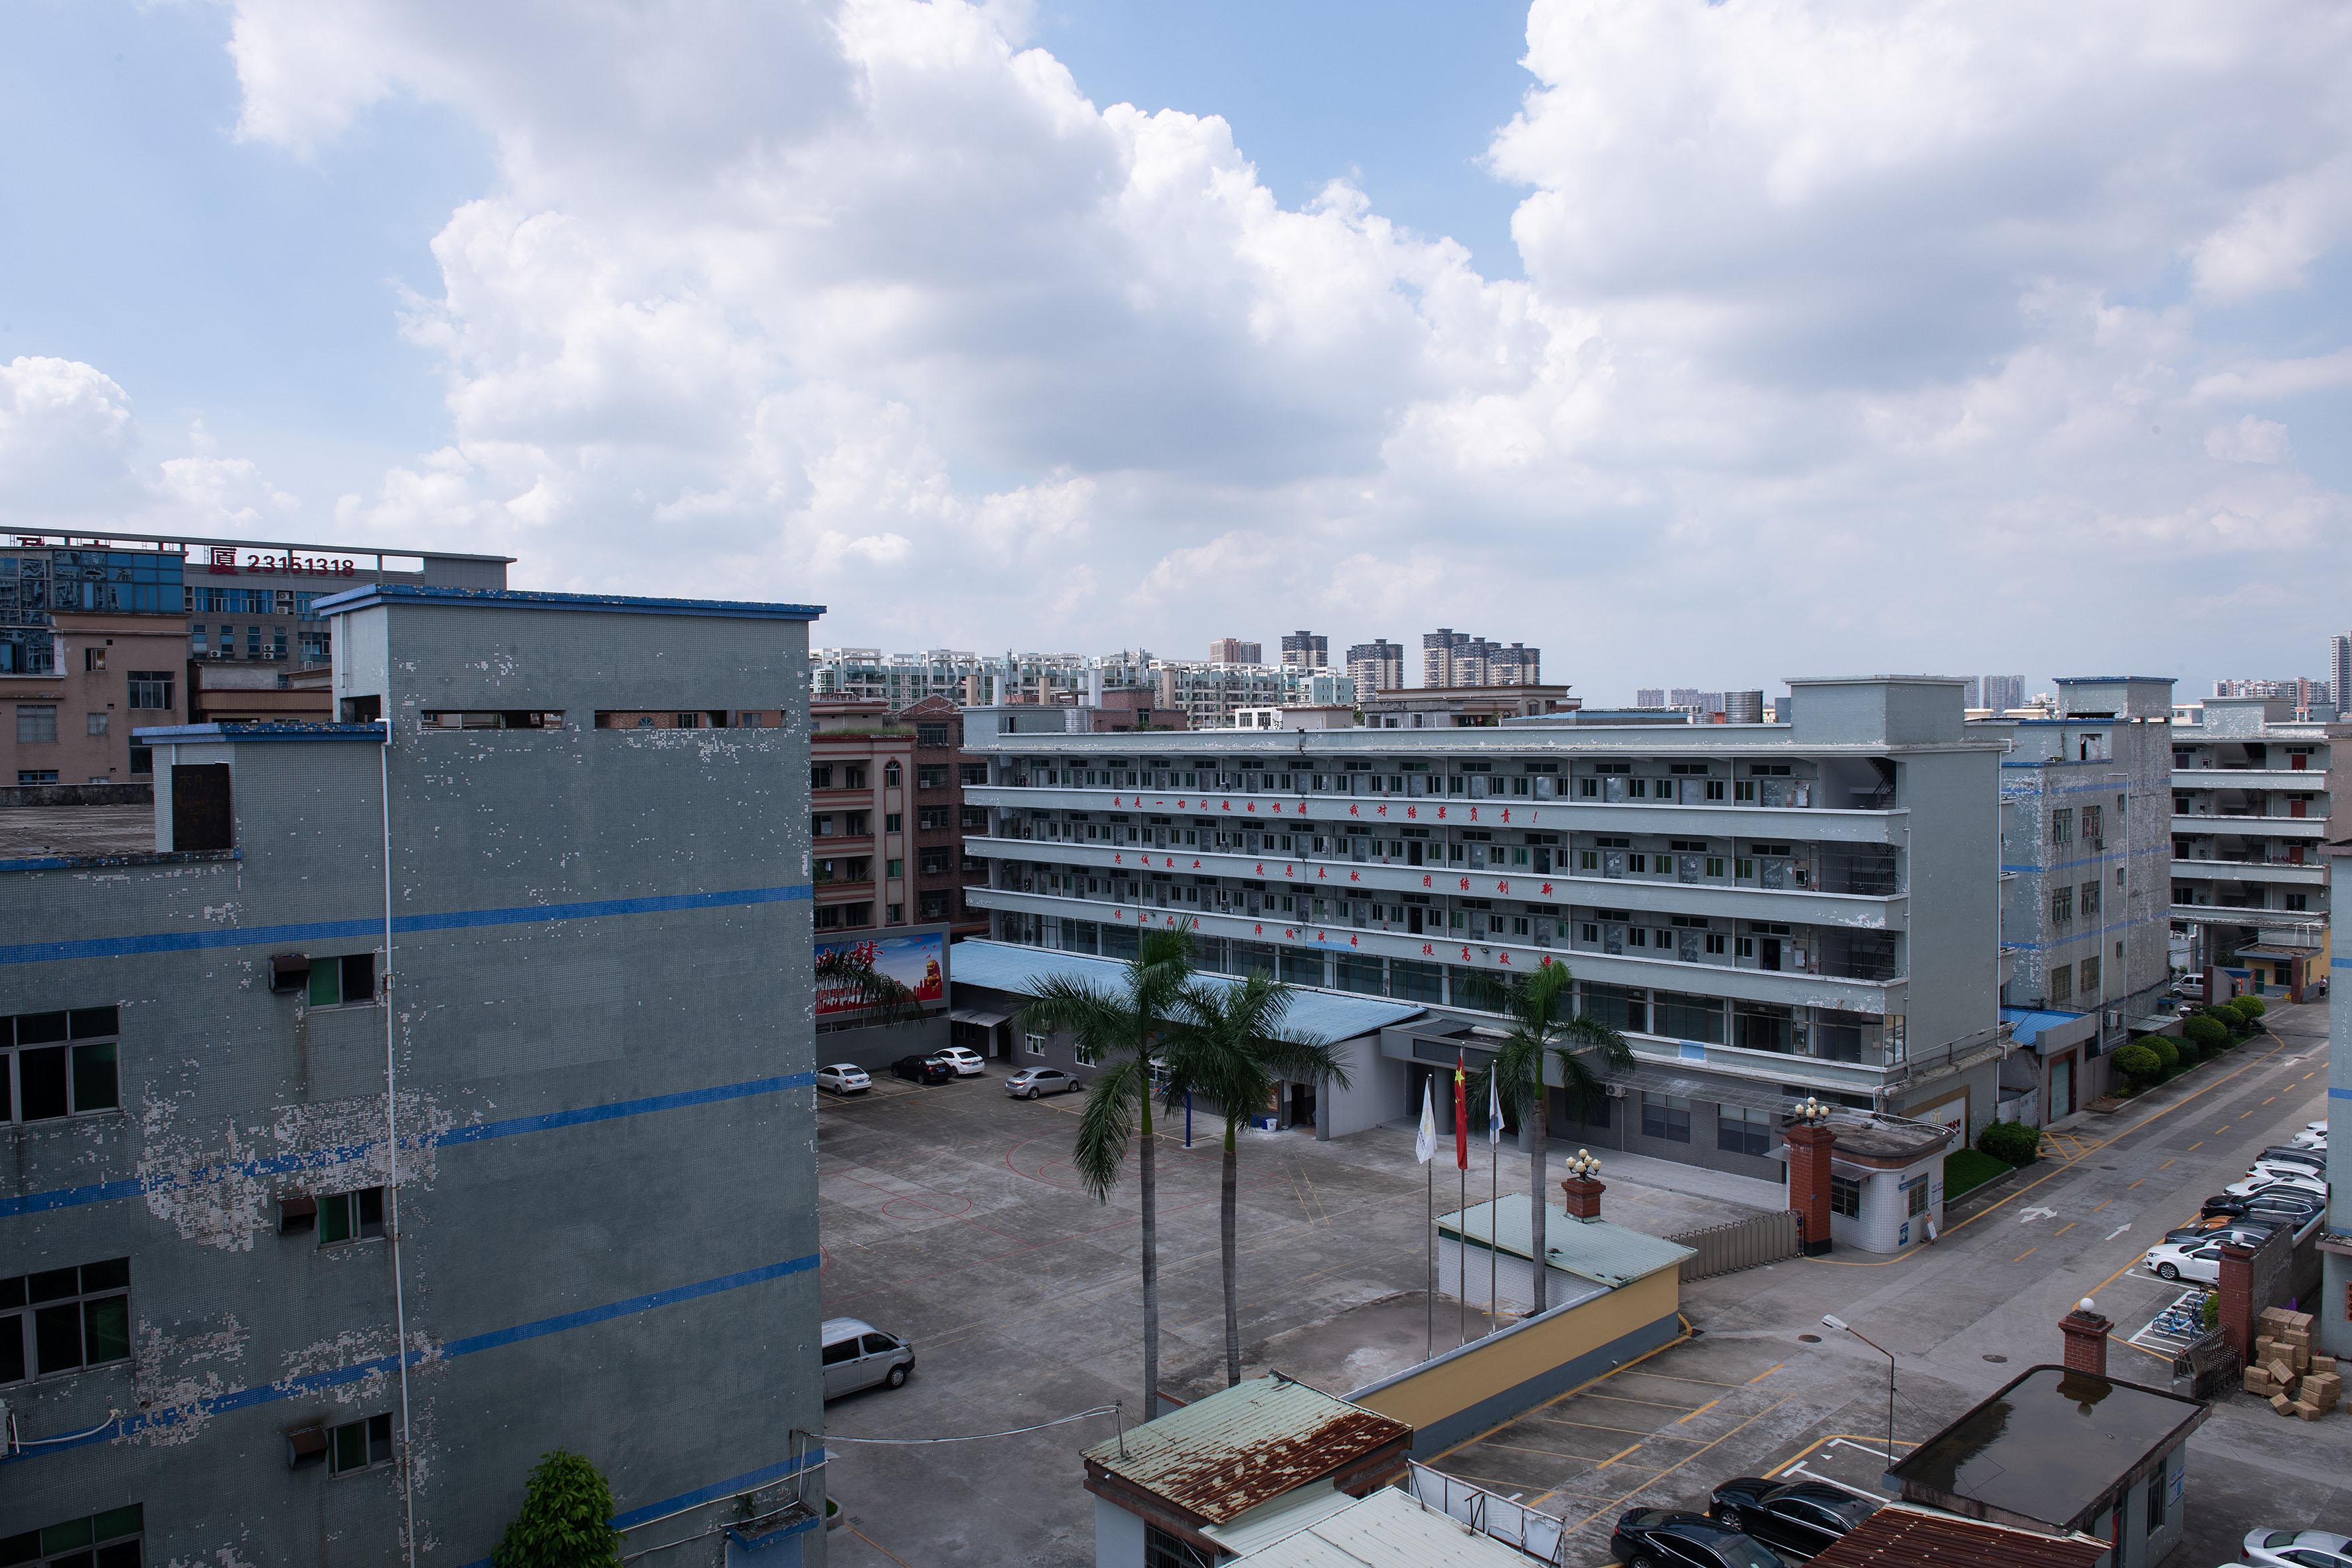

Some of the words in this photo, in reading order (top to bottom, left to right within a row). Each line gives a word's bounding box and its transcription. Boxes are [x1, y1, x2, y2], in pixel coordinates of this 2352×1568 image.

[247, 554, 354, 576] 23151318
[1423, 874, 1554, 898] 团结创新
